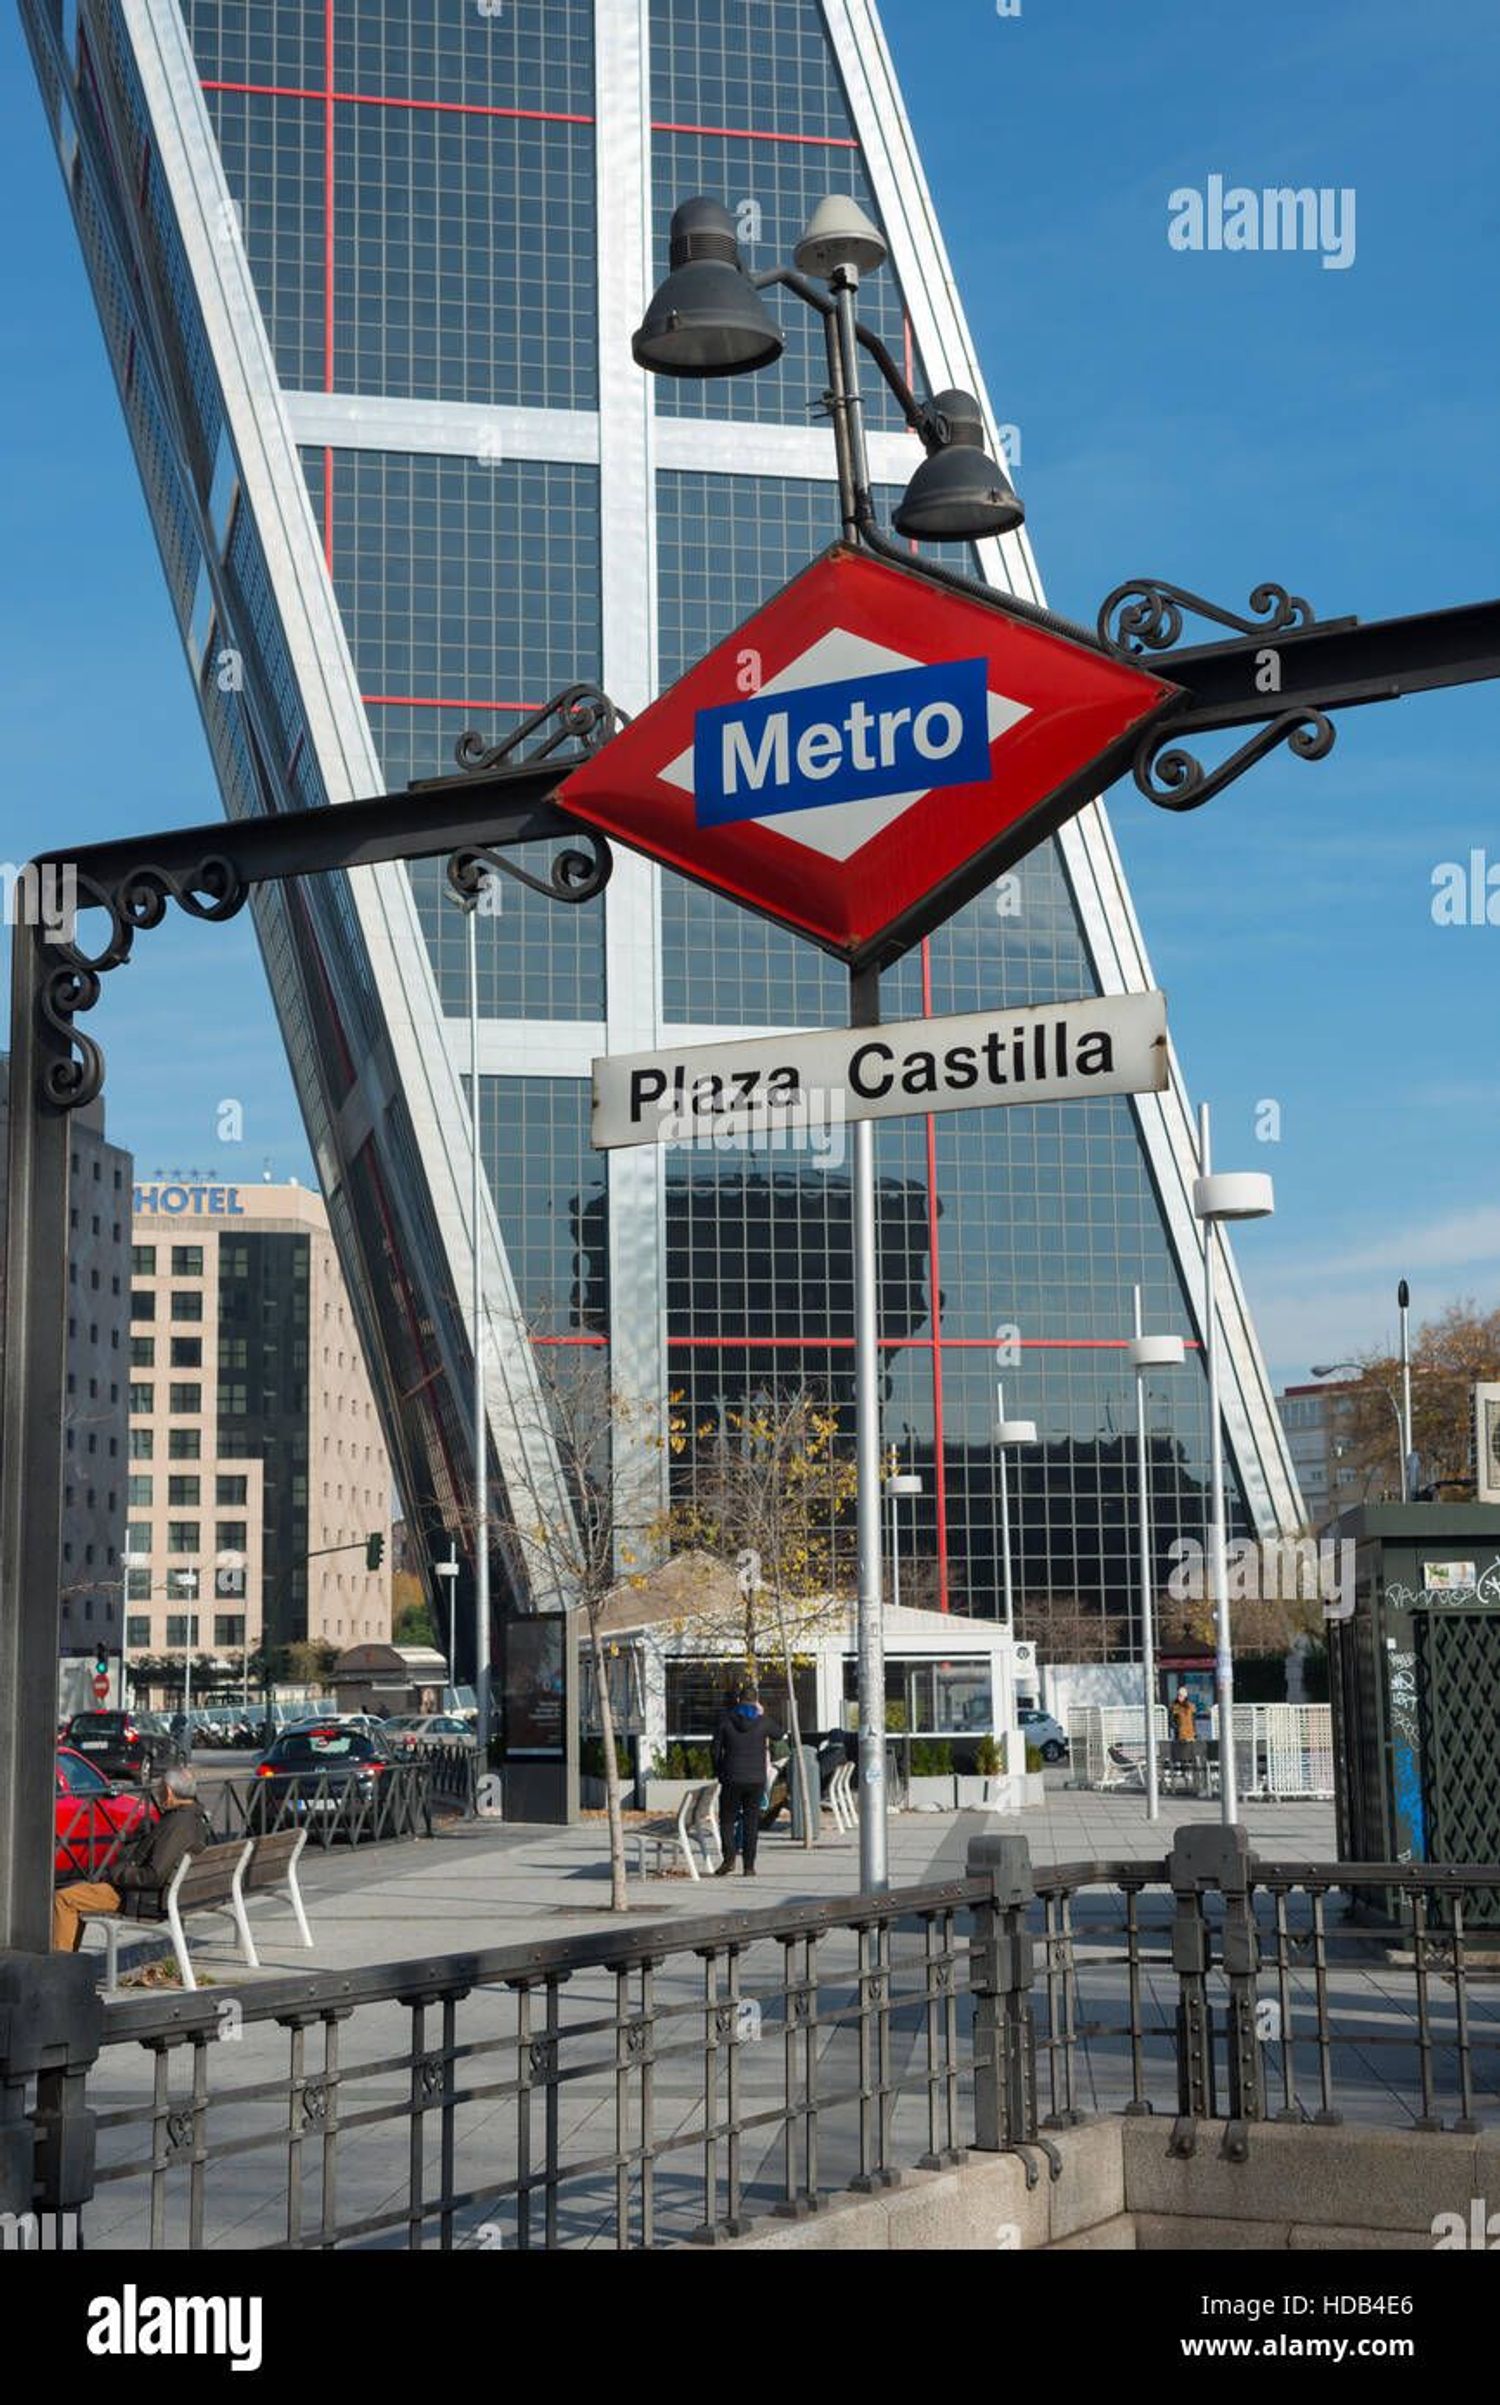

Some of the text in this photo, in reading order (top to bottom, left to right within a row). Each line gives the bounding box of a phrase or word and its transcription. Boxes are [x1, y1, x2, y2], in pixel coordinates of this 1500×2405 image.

[722, 701, 964, 795] Metro
[630, 1021, 1114, 1122] Plaza Castilla
[134, 1186, 245, 1215] HOTEL
